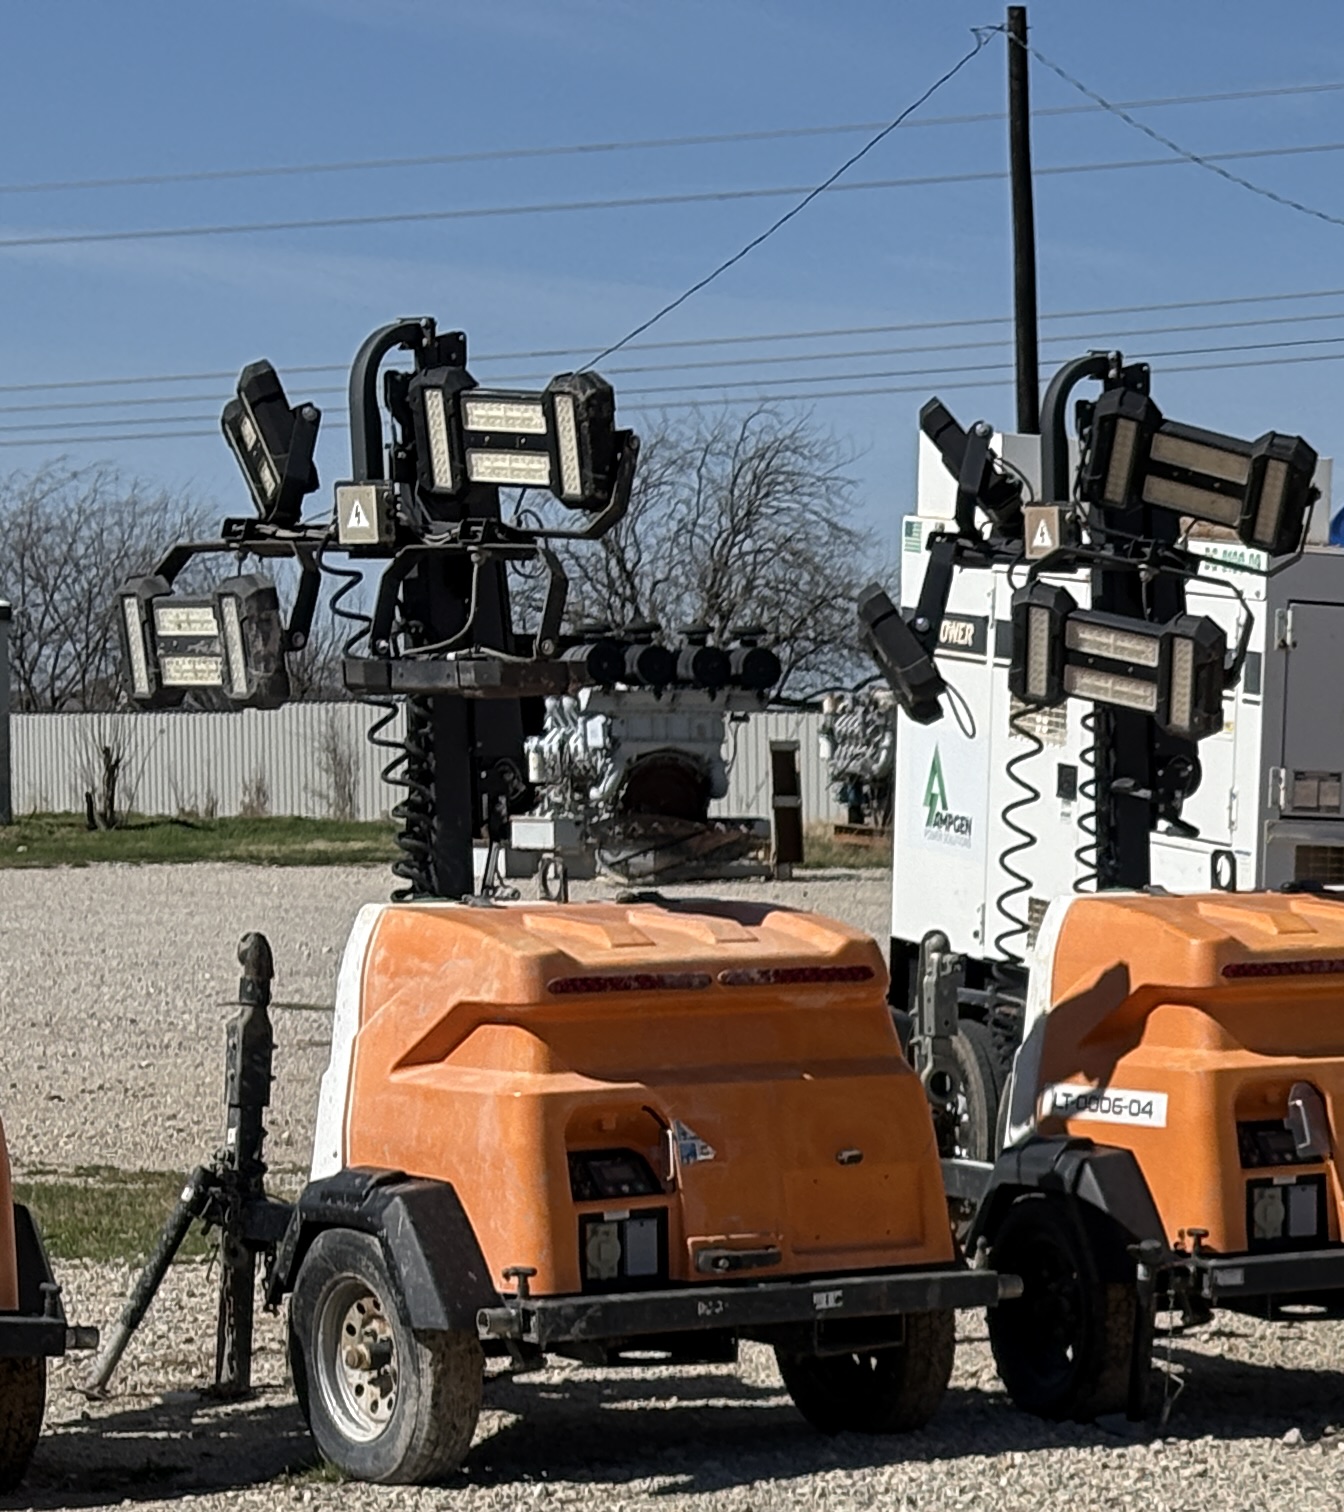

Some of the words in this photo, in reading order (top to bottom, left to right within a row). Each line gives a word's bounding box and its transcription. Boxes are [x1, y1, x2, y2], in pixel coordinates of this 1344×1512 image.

[940, 620, 975, 647] OWER
[933, 811, 973, 836] AMPGEN
[1053, 1091, 1153, 1119] LT-0006-04
